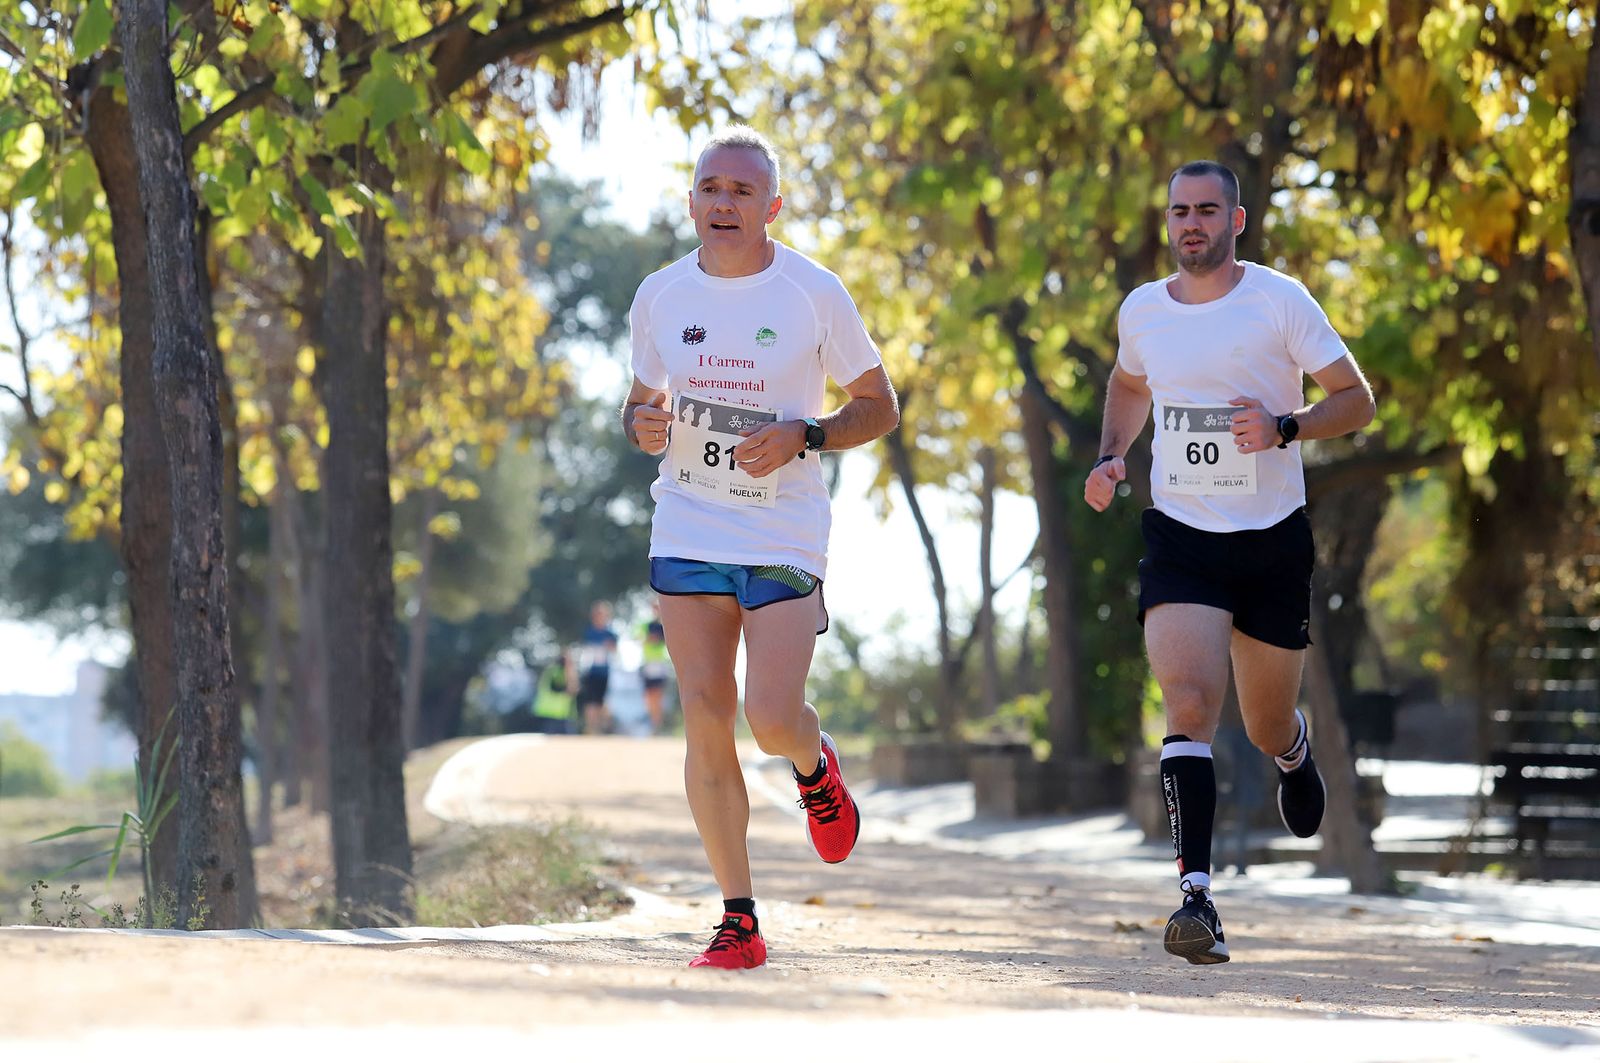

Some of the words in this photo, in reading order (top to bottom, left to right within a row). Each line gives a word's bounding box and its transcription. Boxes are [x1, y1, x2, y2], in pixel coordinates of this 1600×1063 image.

[698, 354, 704, 367] I
[708, 355, 755, 369] Carrera
[688, 377, 765, 392] Sacramental
[1186, 442, 1219, 465] 60
[1213, 479, 1244, 487] HUELVA
[729, 488, 762, 499] HUELVA
